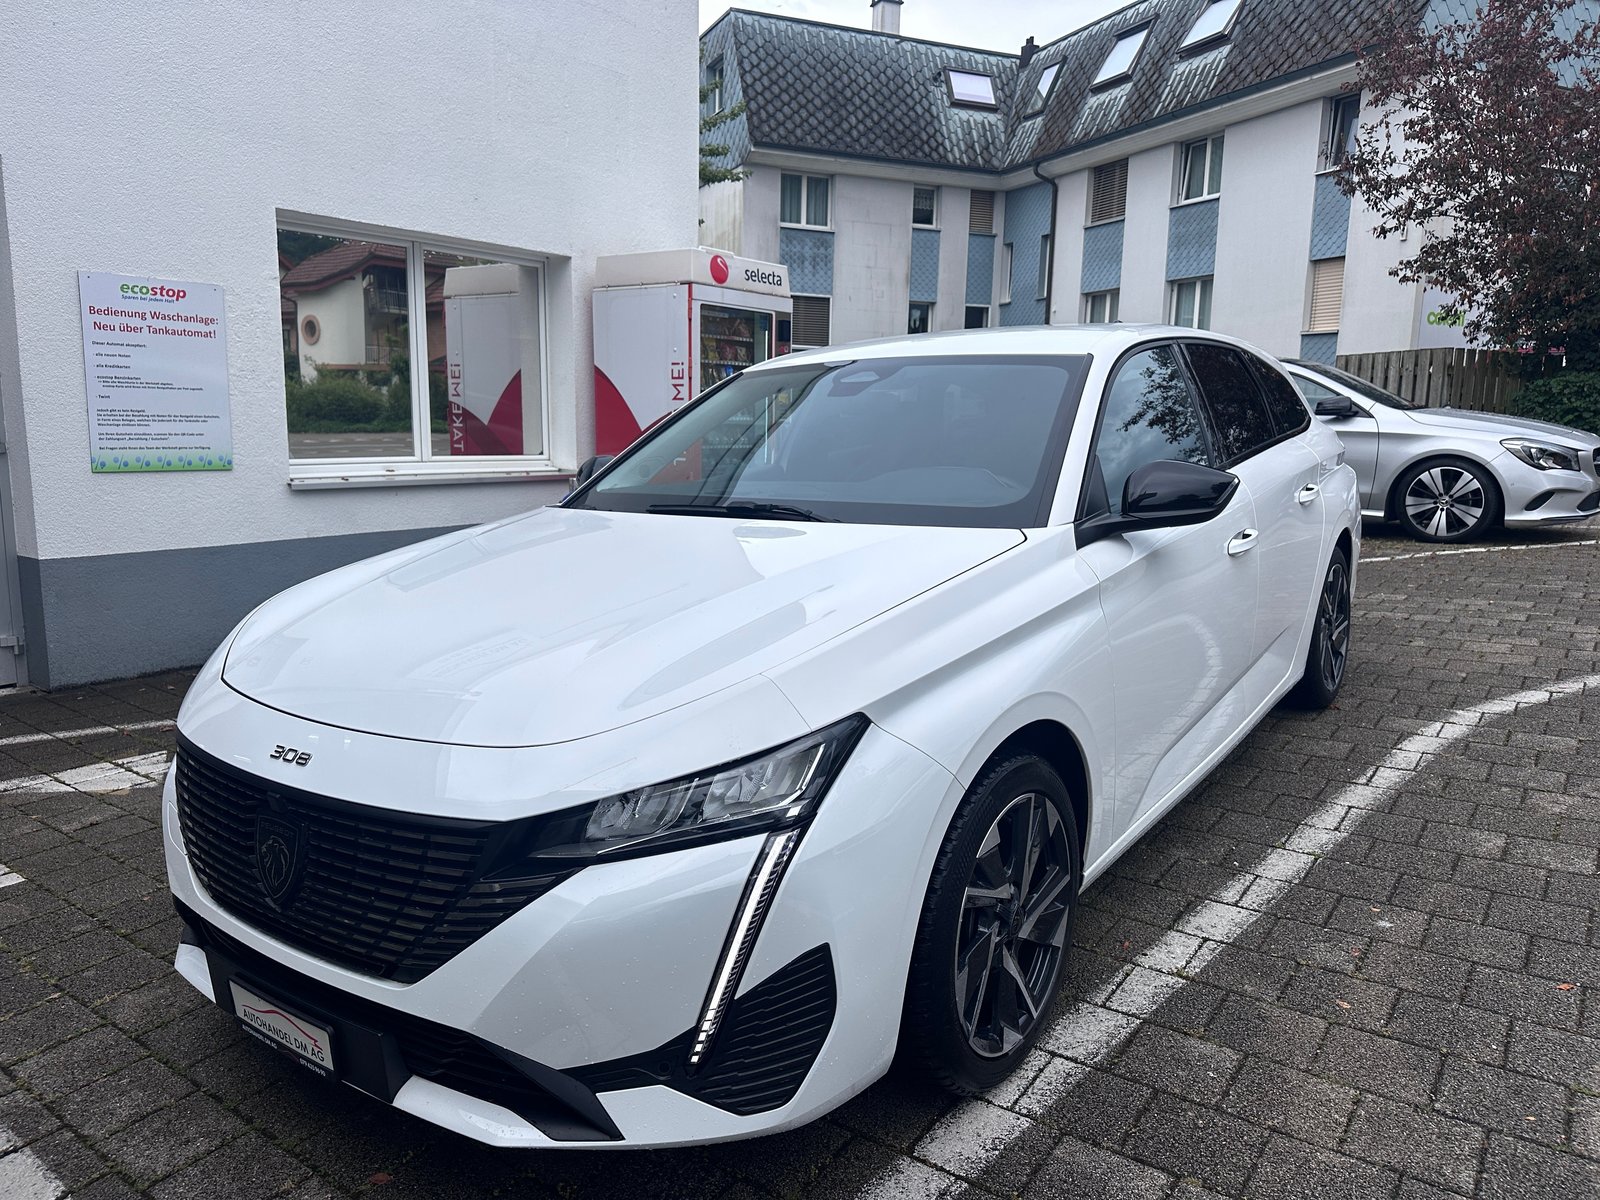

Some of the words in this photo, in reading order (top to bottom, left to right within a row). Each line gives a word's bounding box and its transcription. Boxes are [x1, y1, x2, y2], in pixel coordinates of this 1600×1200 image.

[744, 268, 782, 286] selecta
[120, 283, 187, 301] ecostop
[89, 306, 147, 321] Bedienung
[150, 310, 218, 326] Waschanlage:
[93, 321, 115, 331] Neu
[119, 323, 144, 333] über
[146, 325, 216, 338] Tankautomat!
[671, 362, 684, 401] ME!
[270, 744, 312, 767] 308
[243, 1008, 293, 1046] AUTOHANDEL
[294, 1037, 309, 1054] DM
[311, 1047, 324, 1062] AG
